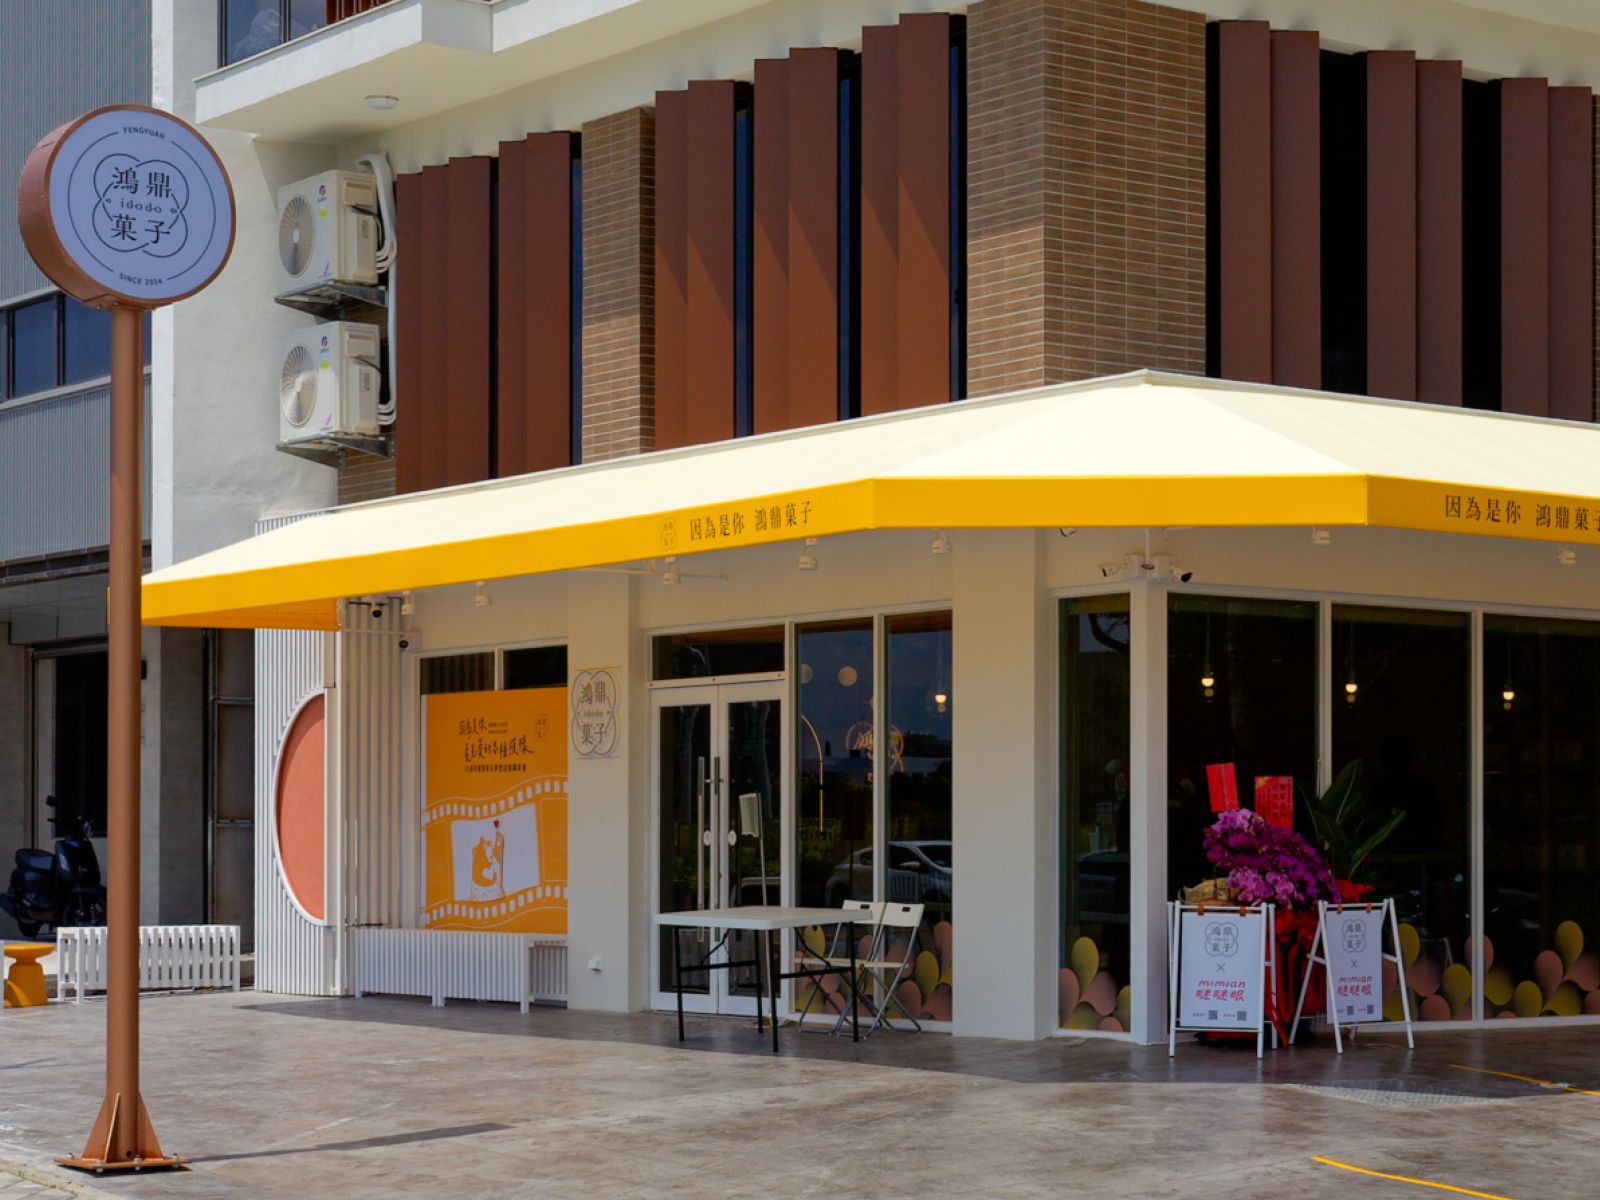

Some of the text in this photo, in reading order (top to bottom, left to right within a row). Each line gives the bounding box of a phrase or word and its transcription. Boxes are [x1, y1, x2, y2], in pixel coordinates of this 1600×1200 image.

[123, 126, 165, 140] FENGYUAN
[111, 166, 172, 199] 鴻鼎
[120, 198, 162, 214] idodo
[110, 213, 171, 244] 菓子
[119, 272, 142, 286] SINCE
[690, 511, 745, 542] 因為是你
[754, 500, 812, 532] 鴻鼎菓子
[1445, 494, 1521, 525] 因為是你
[1198, 979, 1246, 988] mimian
